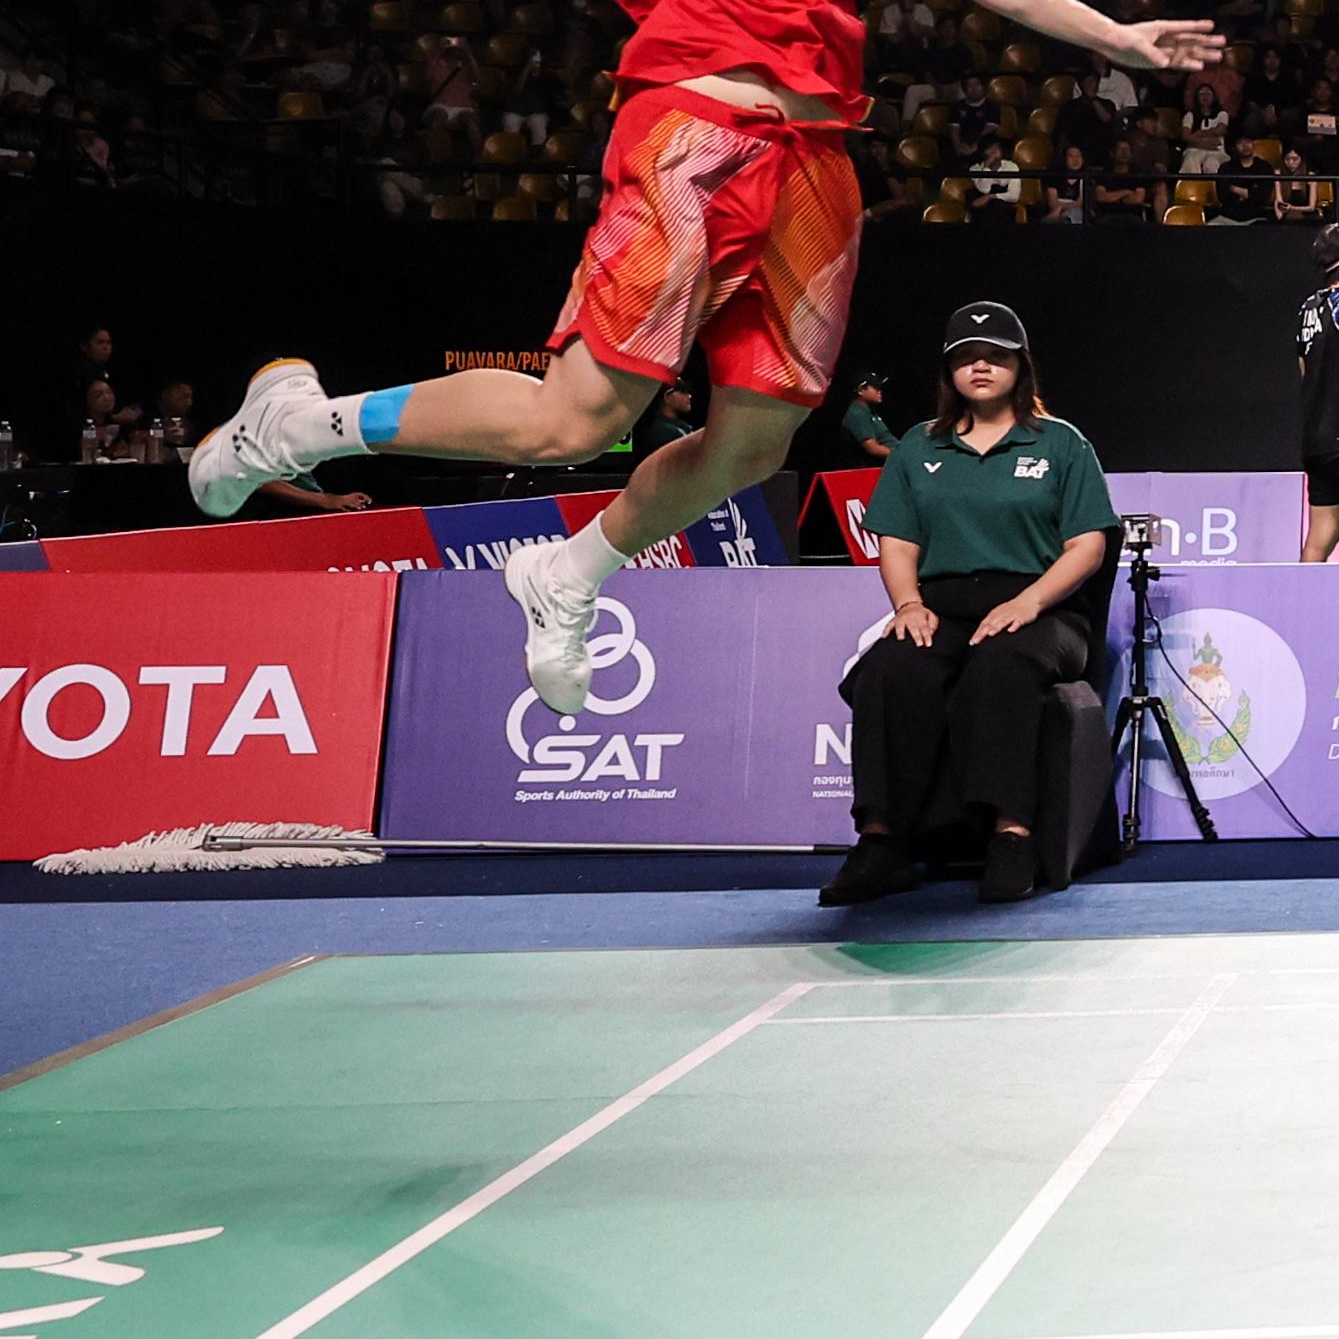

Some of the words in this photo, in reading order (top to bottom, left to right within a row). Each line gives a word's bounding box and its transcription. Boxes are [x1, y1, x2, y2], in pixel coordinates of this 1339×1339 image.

[517, 733, 685, 782] SAT
[514, 790, 553, 802] Sports
[555, 789, 611, 802] Authority
[612, 789, 626, 799] of
[627, 788, 677, 799] Thailand
